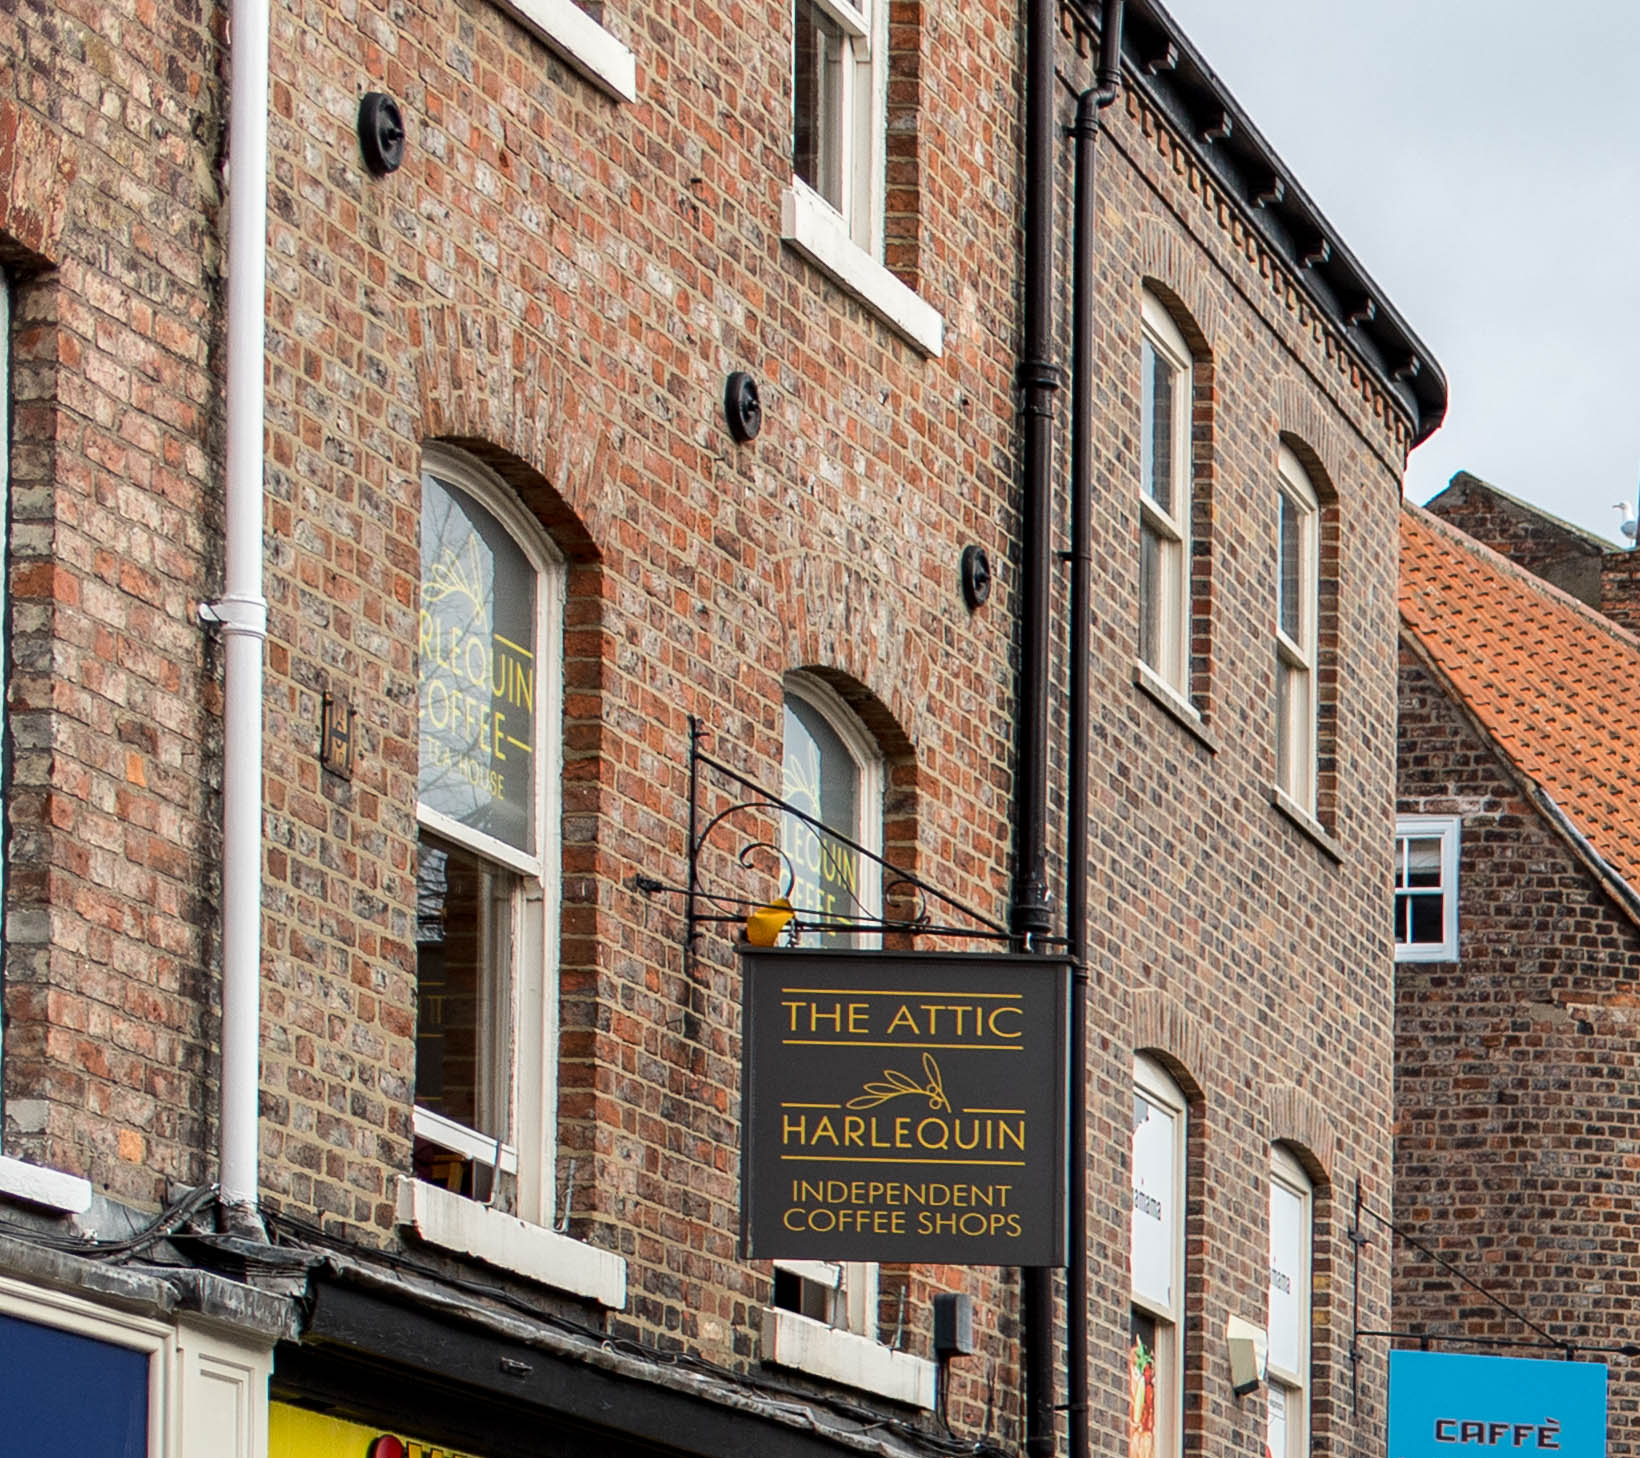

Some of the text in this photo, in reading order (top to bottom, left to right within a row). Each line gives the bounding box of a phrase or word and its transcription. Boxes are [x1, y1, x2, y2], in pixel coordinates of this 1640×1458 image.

[781, 1001, 1023, 1037] THE ATTIC
[781, 1115, 1025, 1150] HARLEQUIN
[793, 1180, 1012, 1208] INDEPENDENT
[783, 1208, 1022, 1237] COFFEE SHOPS
[1435, 1417, 1560, 1449] CAFFÈ
